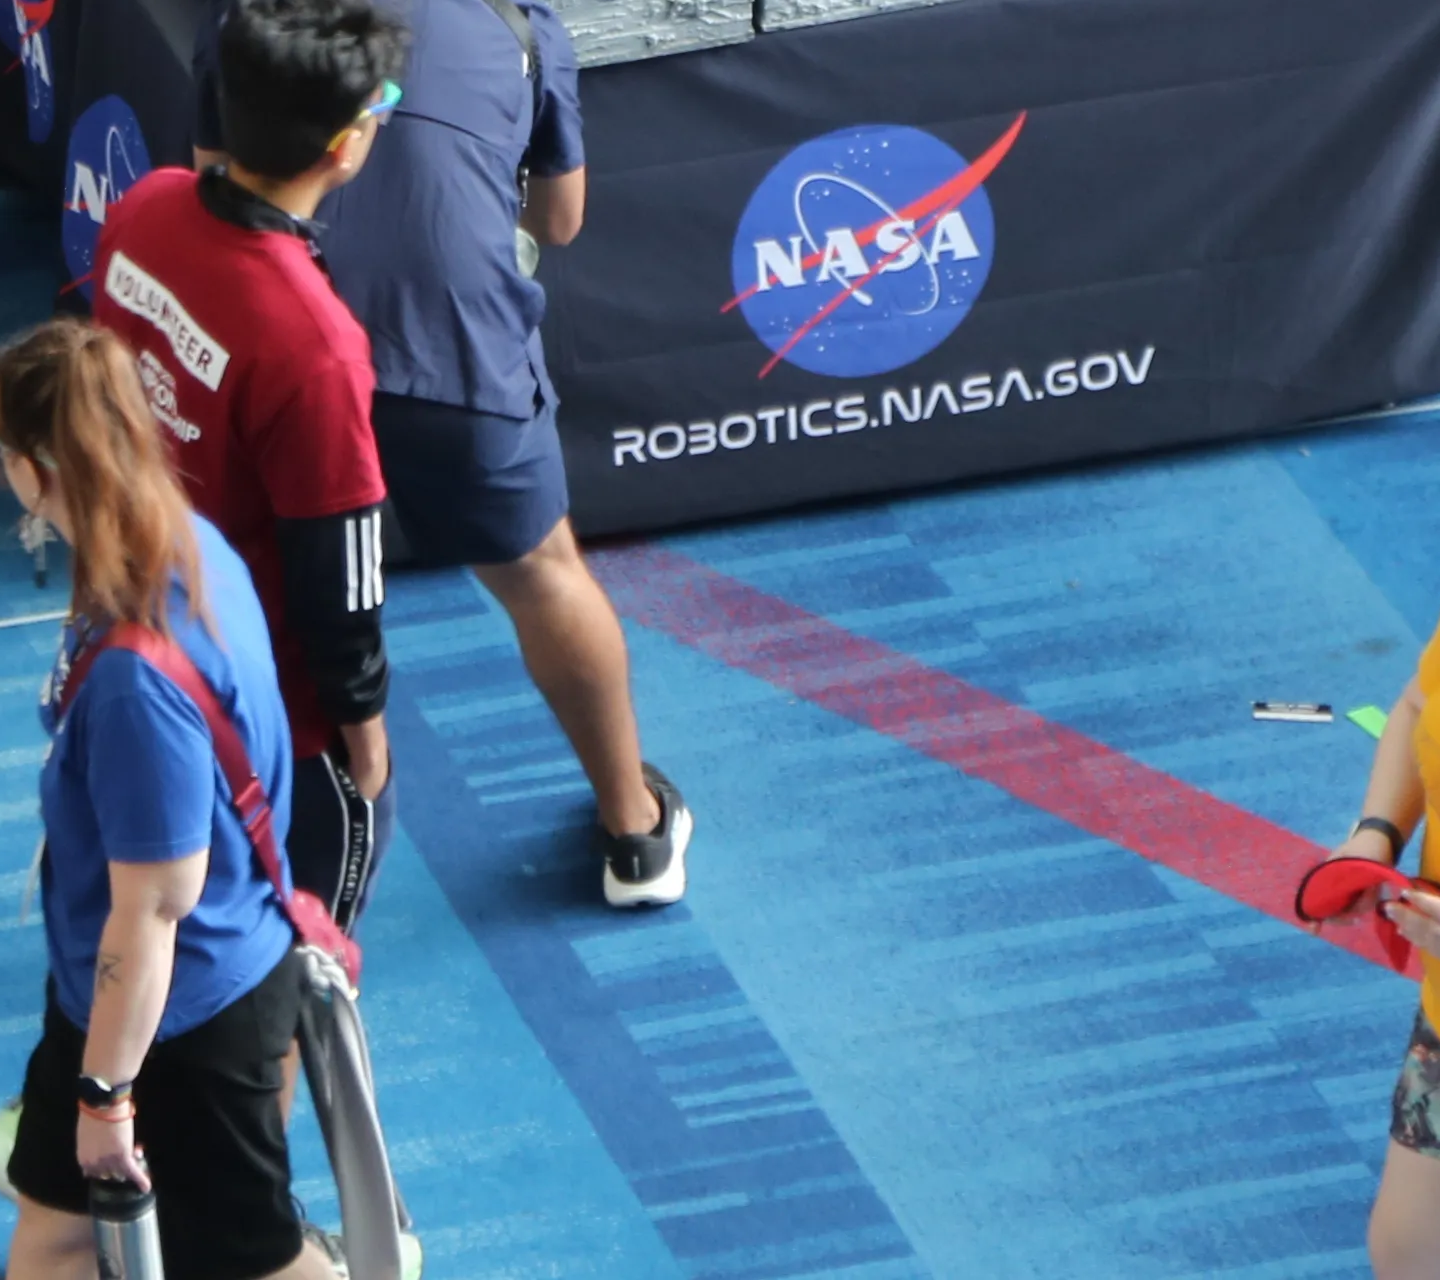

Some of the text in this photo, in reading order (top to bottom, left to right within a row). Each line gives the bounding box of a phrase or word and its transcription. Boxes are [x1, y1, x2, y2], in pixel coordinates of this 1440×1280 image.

[753, 210, 981, 292] NASA
[116, 269, 214, 375] VOLUNTEER
[612, 345, 1155, 467] ROBOTICS.NASA.GOV
